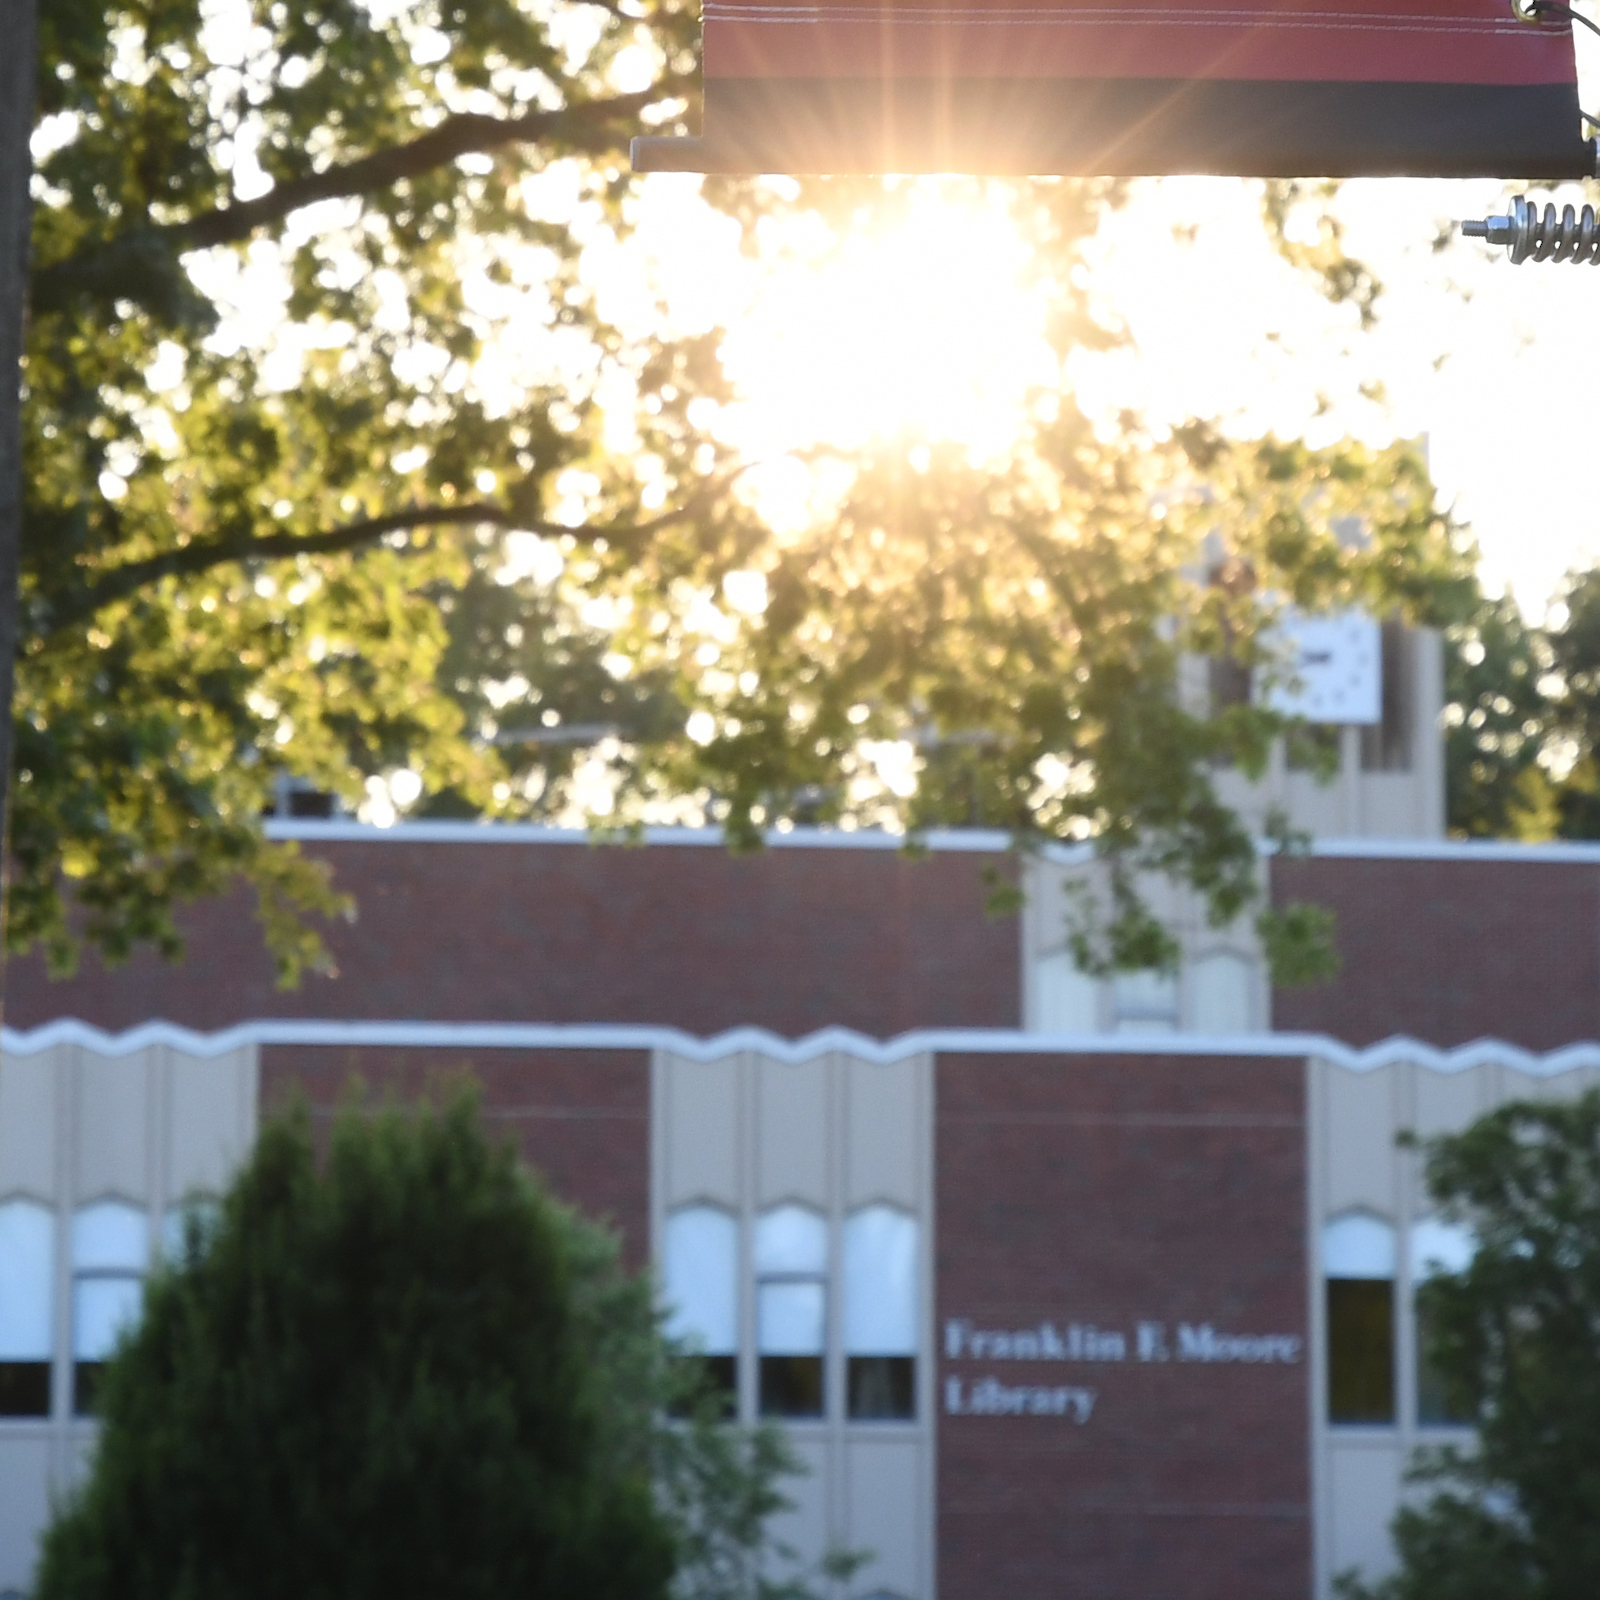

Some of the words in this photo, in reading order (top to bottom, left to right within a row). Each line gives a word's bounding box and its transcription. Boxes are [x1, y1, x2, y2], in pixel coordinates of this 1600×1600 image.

[944, 1318, 1127, 1360] Franklin
[1176, 1321, 1302, 1363] Moore
[944, 1374, 1098, 1425] Library
